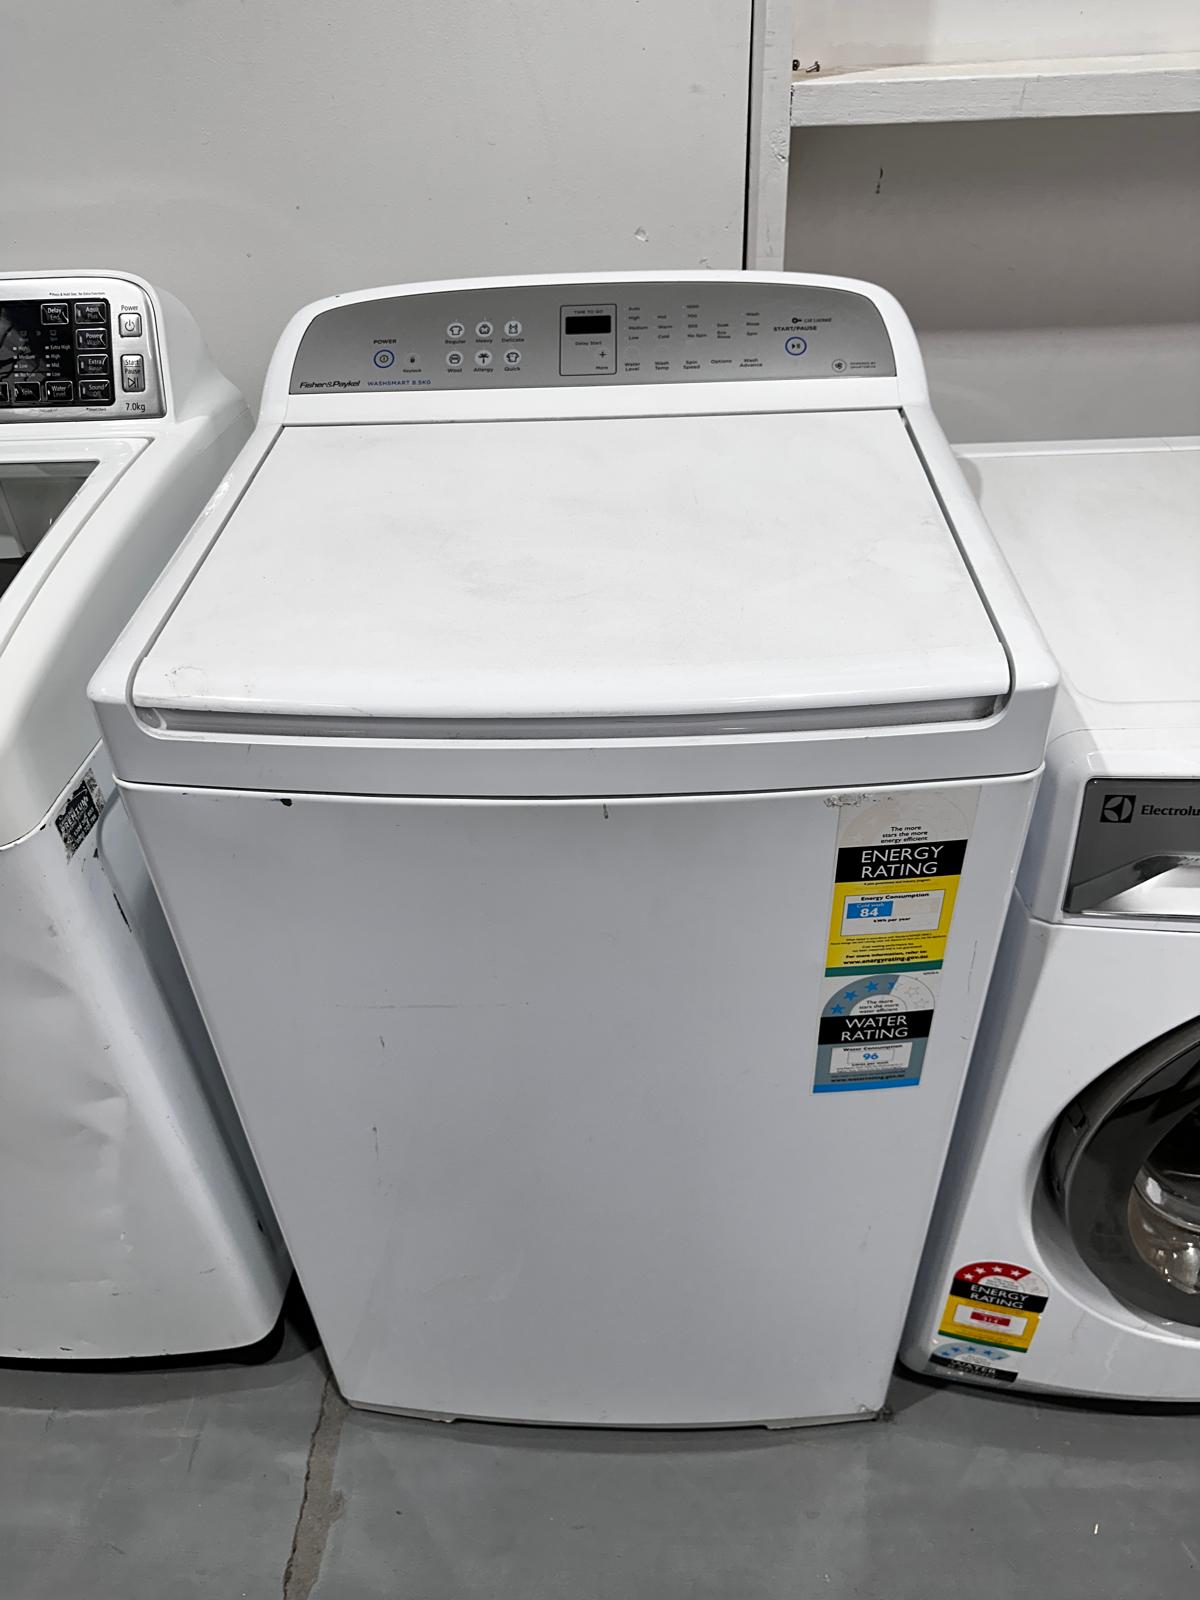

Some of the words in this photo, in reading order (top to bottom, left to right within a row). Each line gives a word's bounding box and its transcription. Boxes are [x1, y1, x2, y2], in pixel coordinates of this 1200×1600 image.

[299, 380, 361, 389] Fisher&Paykel
[125, 402, 146, 412] 7.0kg
[861, 845, 944, 863] ENERGY
[861, 862, 938, 878] RATING
[860, 907, 879, 917] 84
[843, 955, 928, 965] www.energyrating.gov.au
[845, 1015, 907, 1029] WATER
[841, 1027, 908, 1041] RATING
[970, 1284, 1029, 1301] ENERGY
[970, 1293, 1023, 1309] RATING
